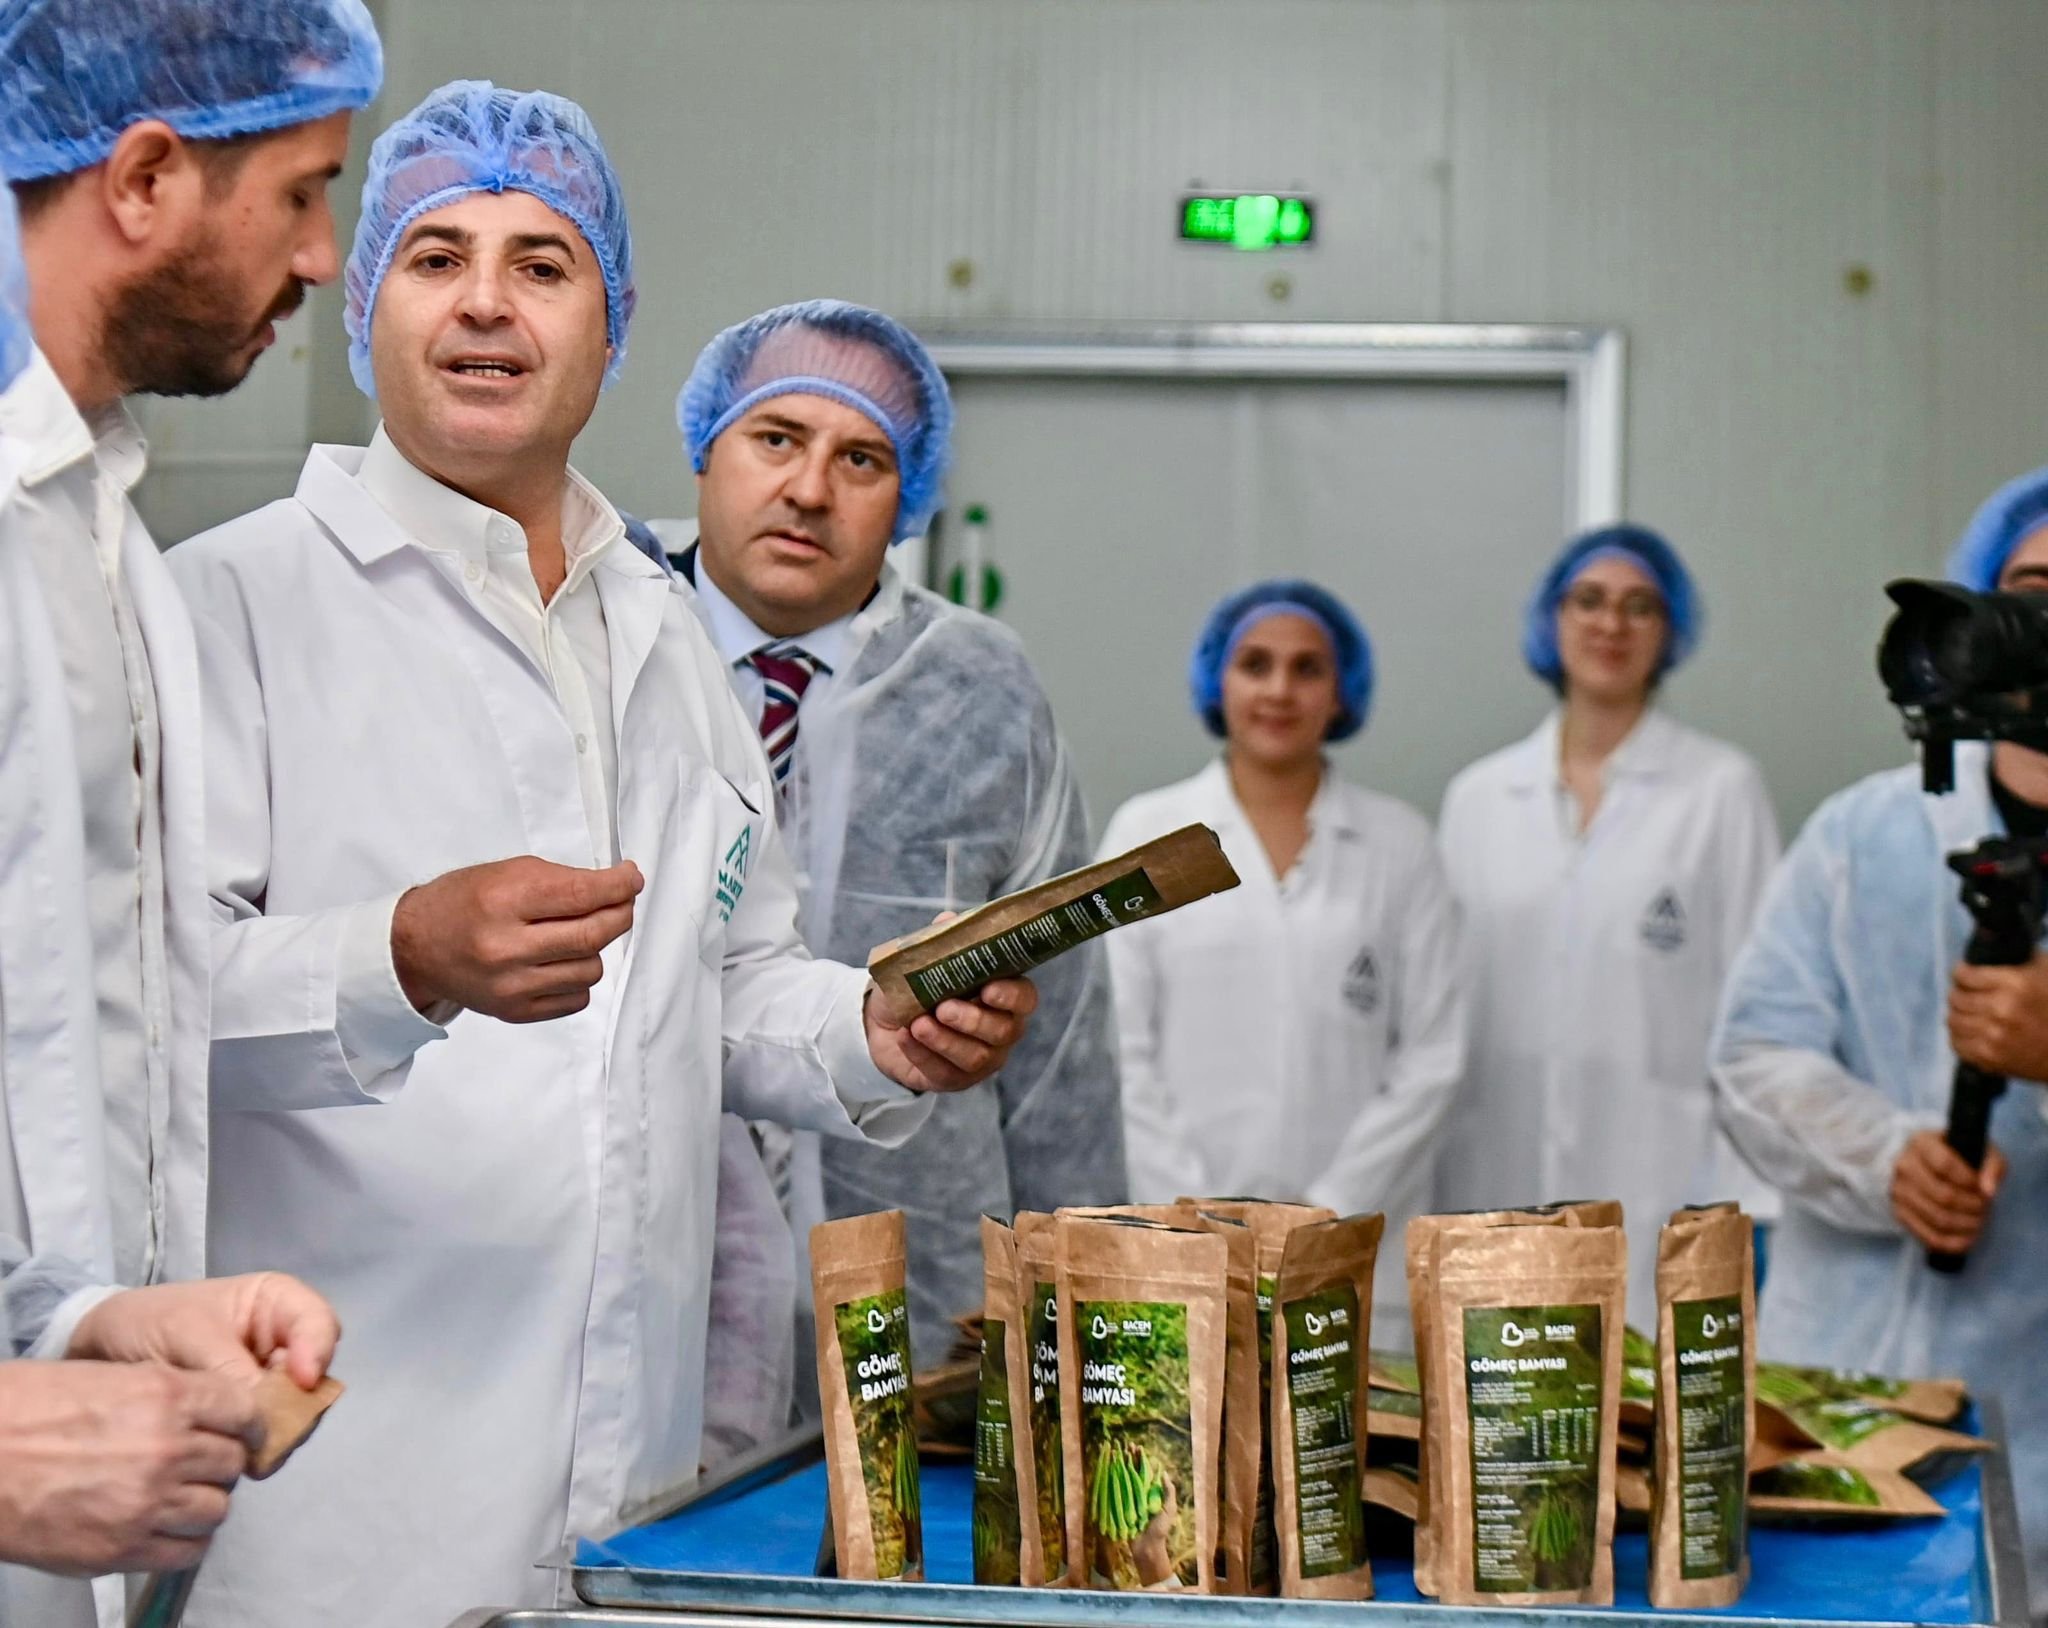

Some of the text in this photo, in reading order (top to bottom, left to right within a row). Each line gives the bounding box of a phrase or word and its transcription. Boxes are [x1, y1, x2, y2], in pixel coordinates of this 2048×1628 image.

[857, 1352, 903, 1379] GÖMEÇ
[1291, 1348, 1325, 1365] GÖMEÇ
[1470, 1357, 1568, 1375] GÖMEÇ BAMYASI
[1083, 1360, 1126, 1387] GÖMEÇ
[1082, 1387, 1136, 1406] BAMYASI
